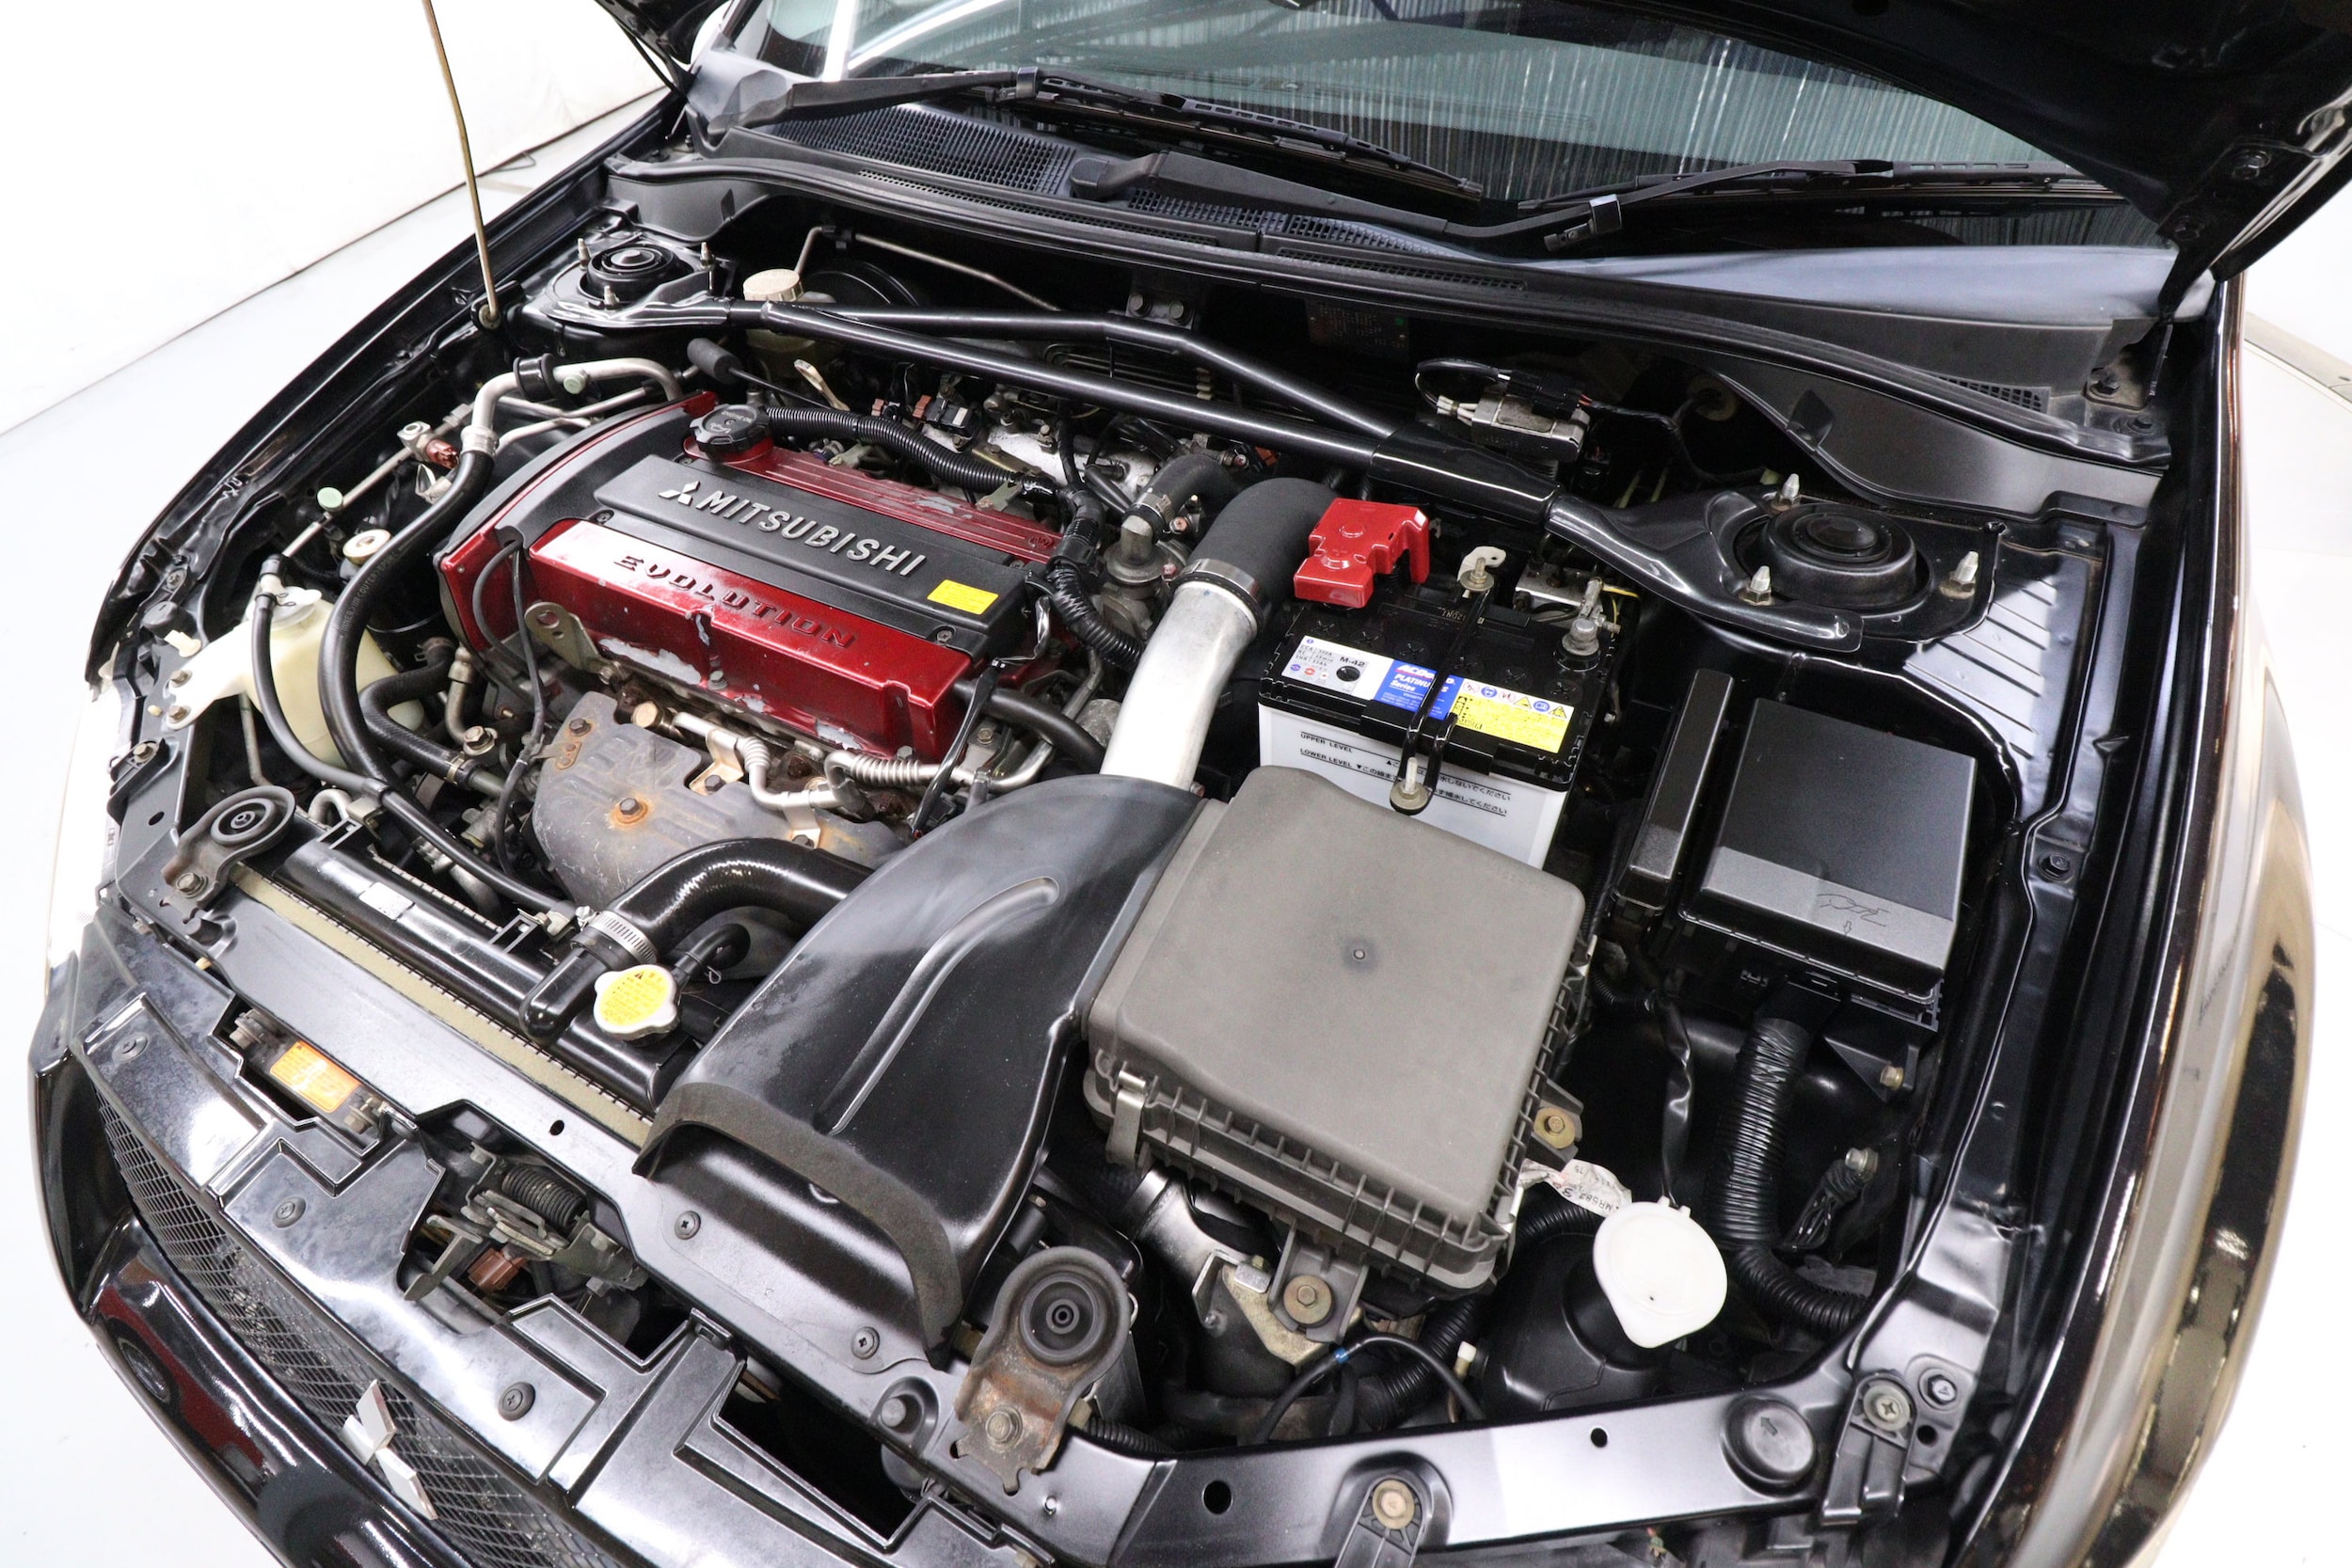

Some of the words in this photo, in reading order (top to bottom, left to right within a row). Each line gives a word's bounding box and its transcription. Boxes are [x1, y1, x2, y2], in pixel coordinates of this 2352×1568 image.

[721, 410, 744, 421] ENGINE
[695, 489, 927, 576] MITSUBISHI
[613, 555, 856, 649] EVOLUTION
[1340, 657, 1366, 668] M-42
[1391, 680, 1416, 692] Series
[1300, 733, 1326, 745] UPPER
[1329, 742, 1353, 753] LEVEL
[1299, 748, 1327, 760] LOWER
[1328, 755, 1352, 768] LEVEL
